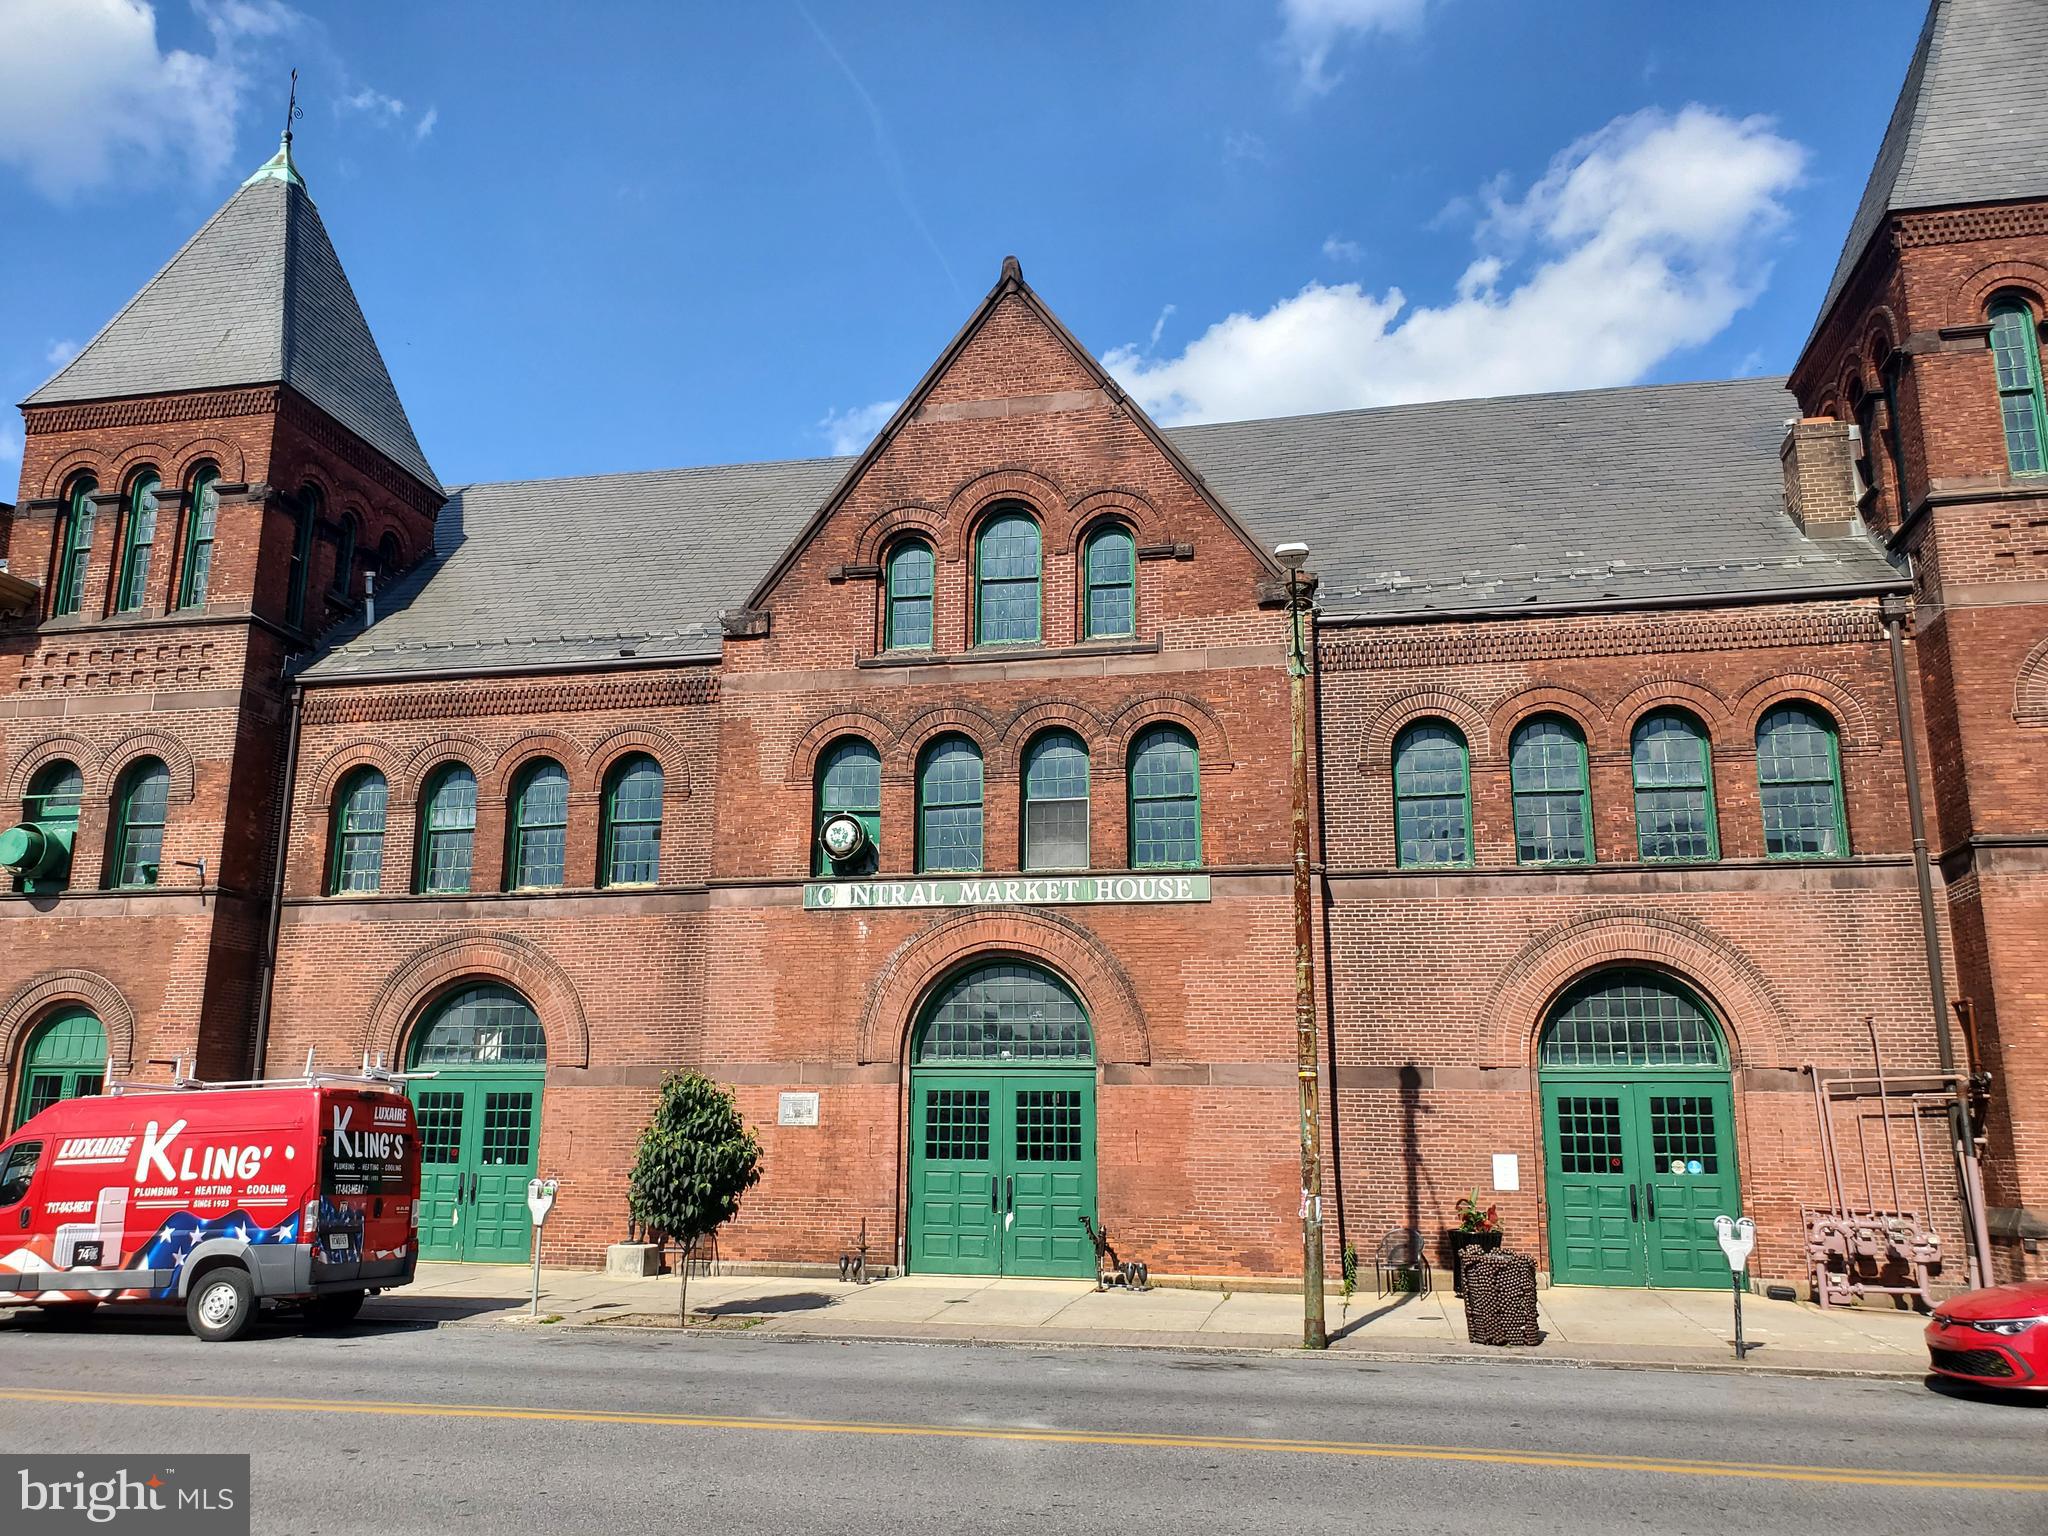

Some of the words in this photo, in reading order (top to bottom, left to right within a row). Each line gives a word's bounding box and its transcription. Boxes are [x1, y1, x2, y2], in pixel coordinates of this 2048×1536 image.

[818, 883, 945, 906] CNTRAL
[958, 880, 1079, 903] MARKET
[1095, 878, 1193, 899] HOUSE
[375, 1106, 407, 1121] LUXAIRE
[57, 1137, 136, 1159] LUXAIRE
[134, 1187, 178, 1197] PLUMBING
[195, 1186, 232, 1195] HEATING
[246, 1184, 286, 1194] COOLING
[193, 1200, 212, 1208] SINCE
[213, 1199, 230, 1207] 1923
